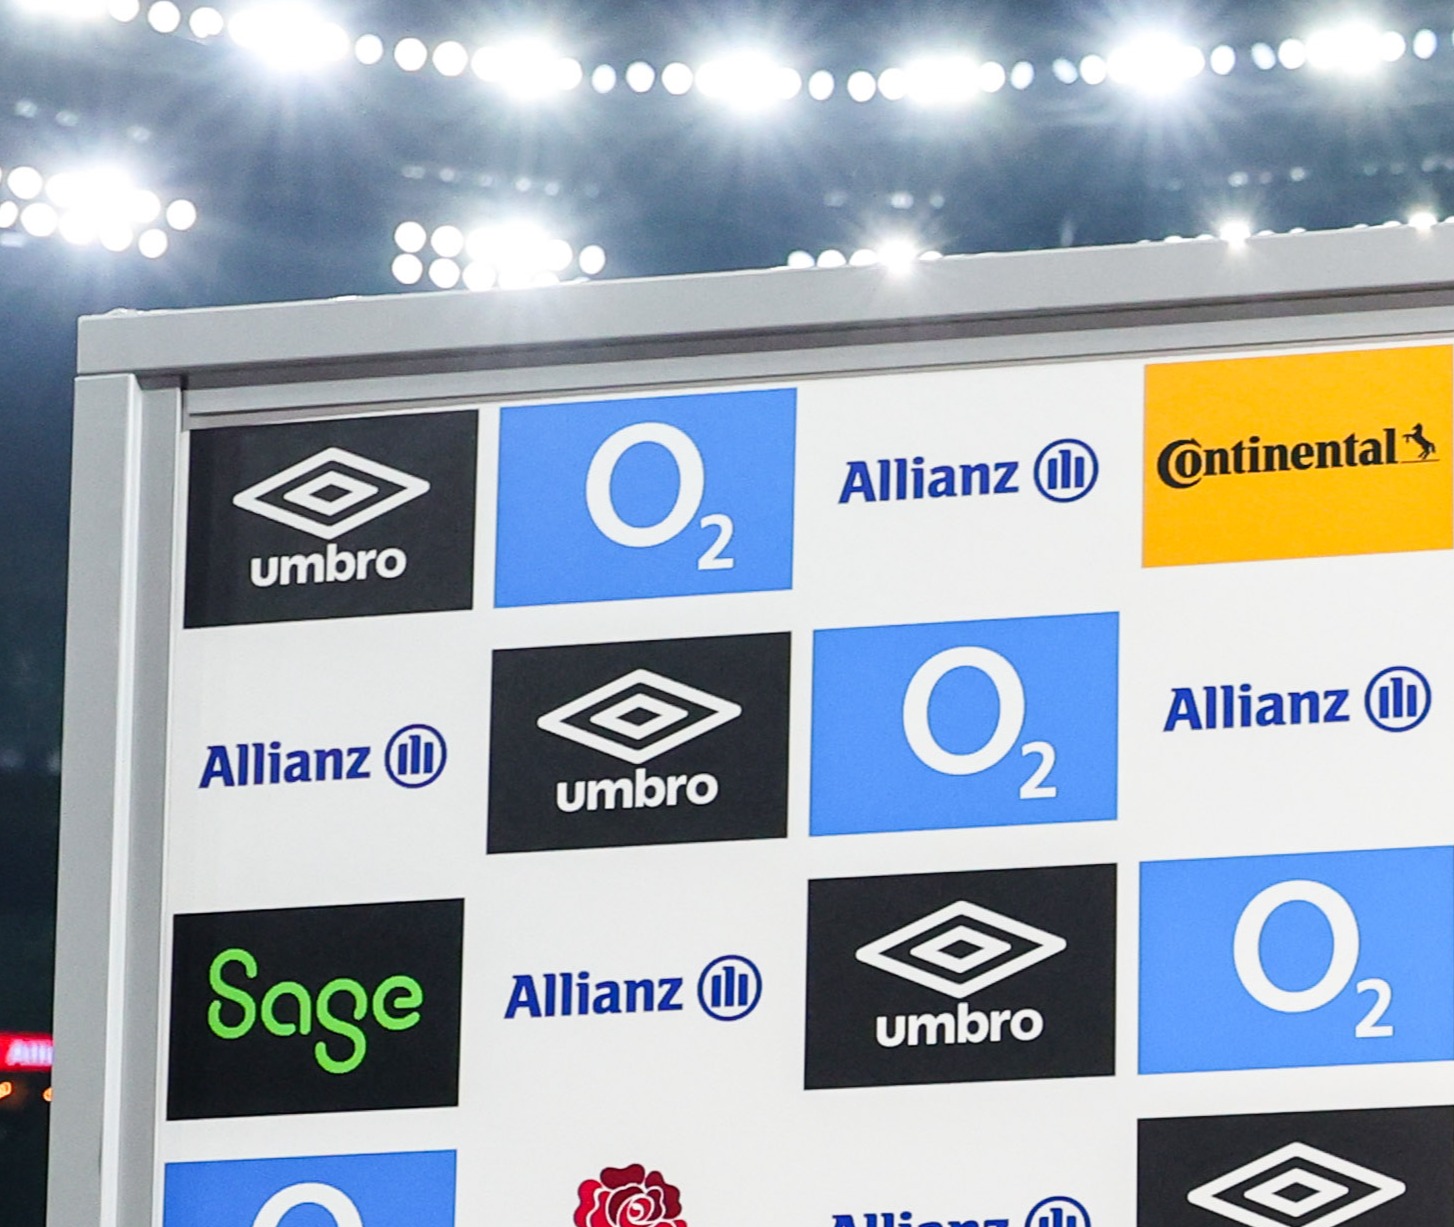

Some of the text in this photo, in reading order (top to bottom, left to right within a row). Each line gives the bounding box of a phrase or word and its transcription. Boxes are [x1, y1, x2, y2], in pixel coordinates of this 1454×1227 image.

[838, 455, 1020, 504] Allianz
[1157, 428, 1398, 489] Continental
[250, 543, 407, 587] umbro
[1163, 683, 1350, 732] Allianz
[199, 740, 371, 788] Allianz
[556, 767, 719, 813] umbro
[208, 948, 423, 1074] Sage
[504, 970, 684, 1020] Allianz
[876, 1002, 1044, 1048] umbro
